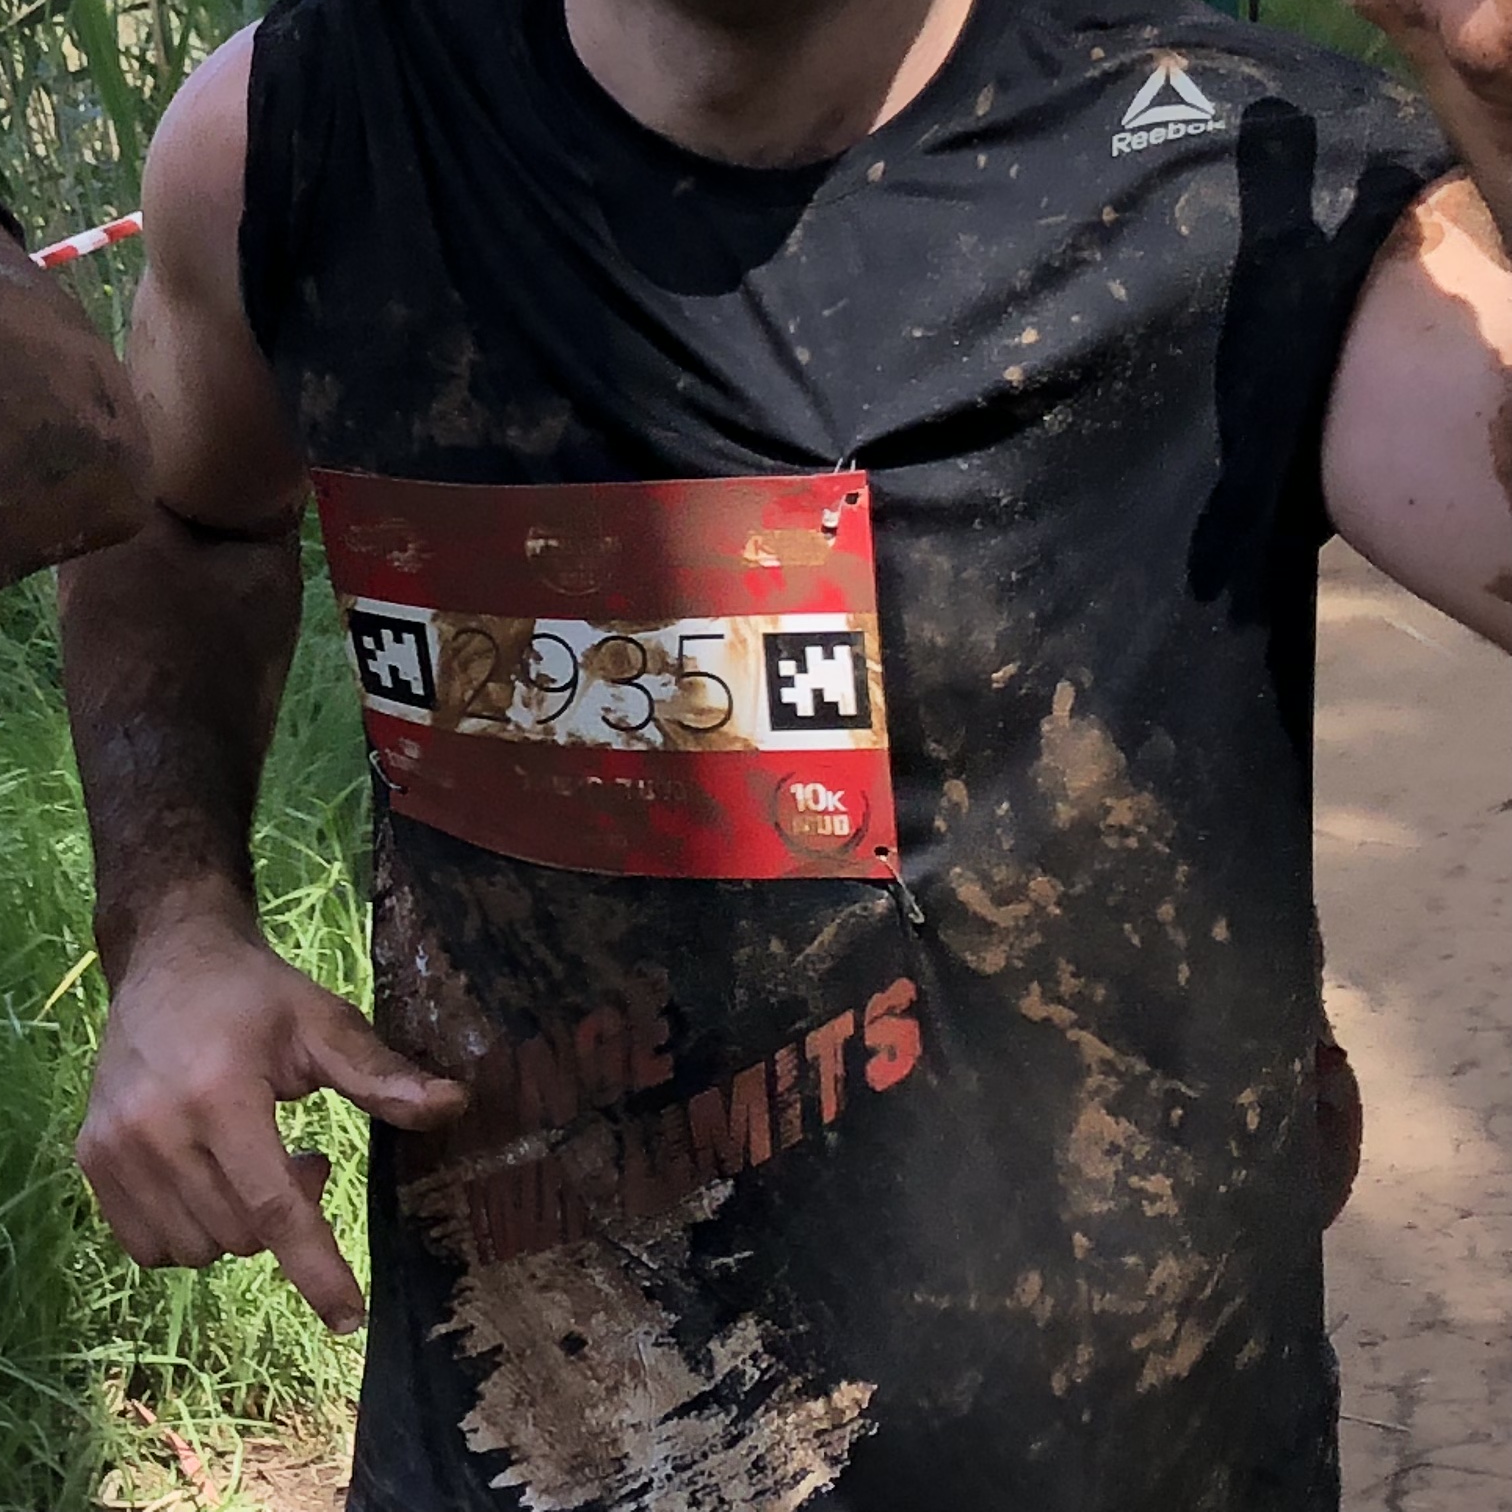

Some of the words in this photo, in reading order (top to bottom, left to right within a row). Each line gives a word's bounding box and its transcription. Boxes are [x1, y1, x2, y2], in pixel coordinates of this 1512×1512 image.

[1112, 119, 1226, 158] Reebok
[451, 628, 735, 734] 2935
[790, 782, 848, 812] 10K
